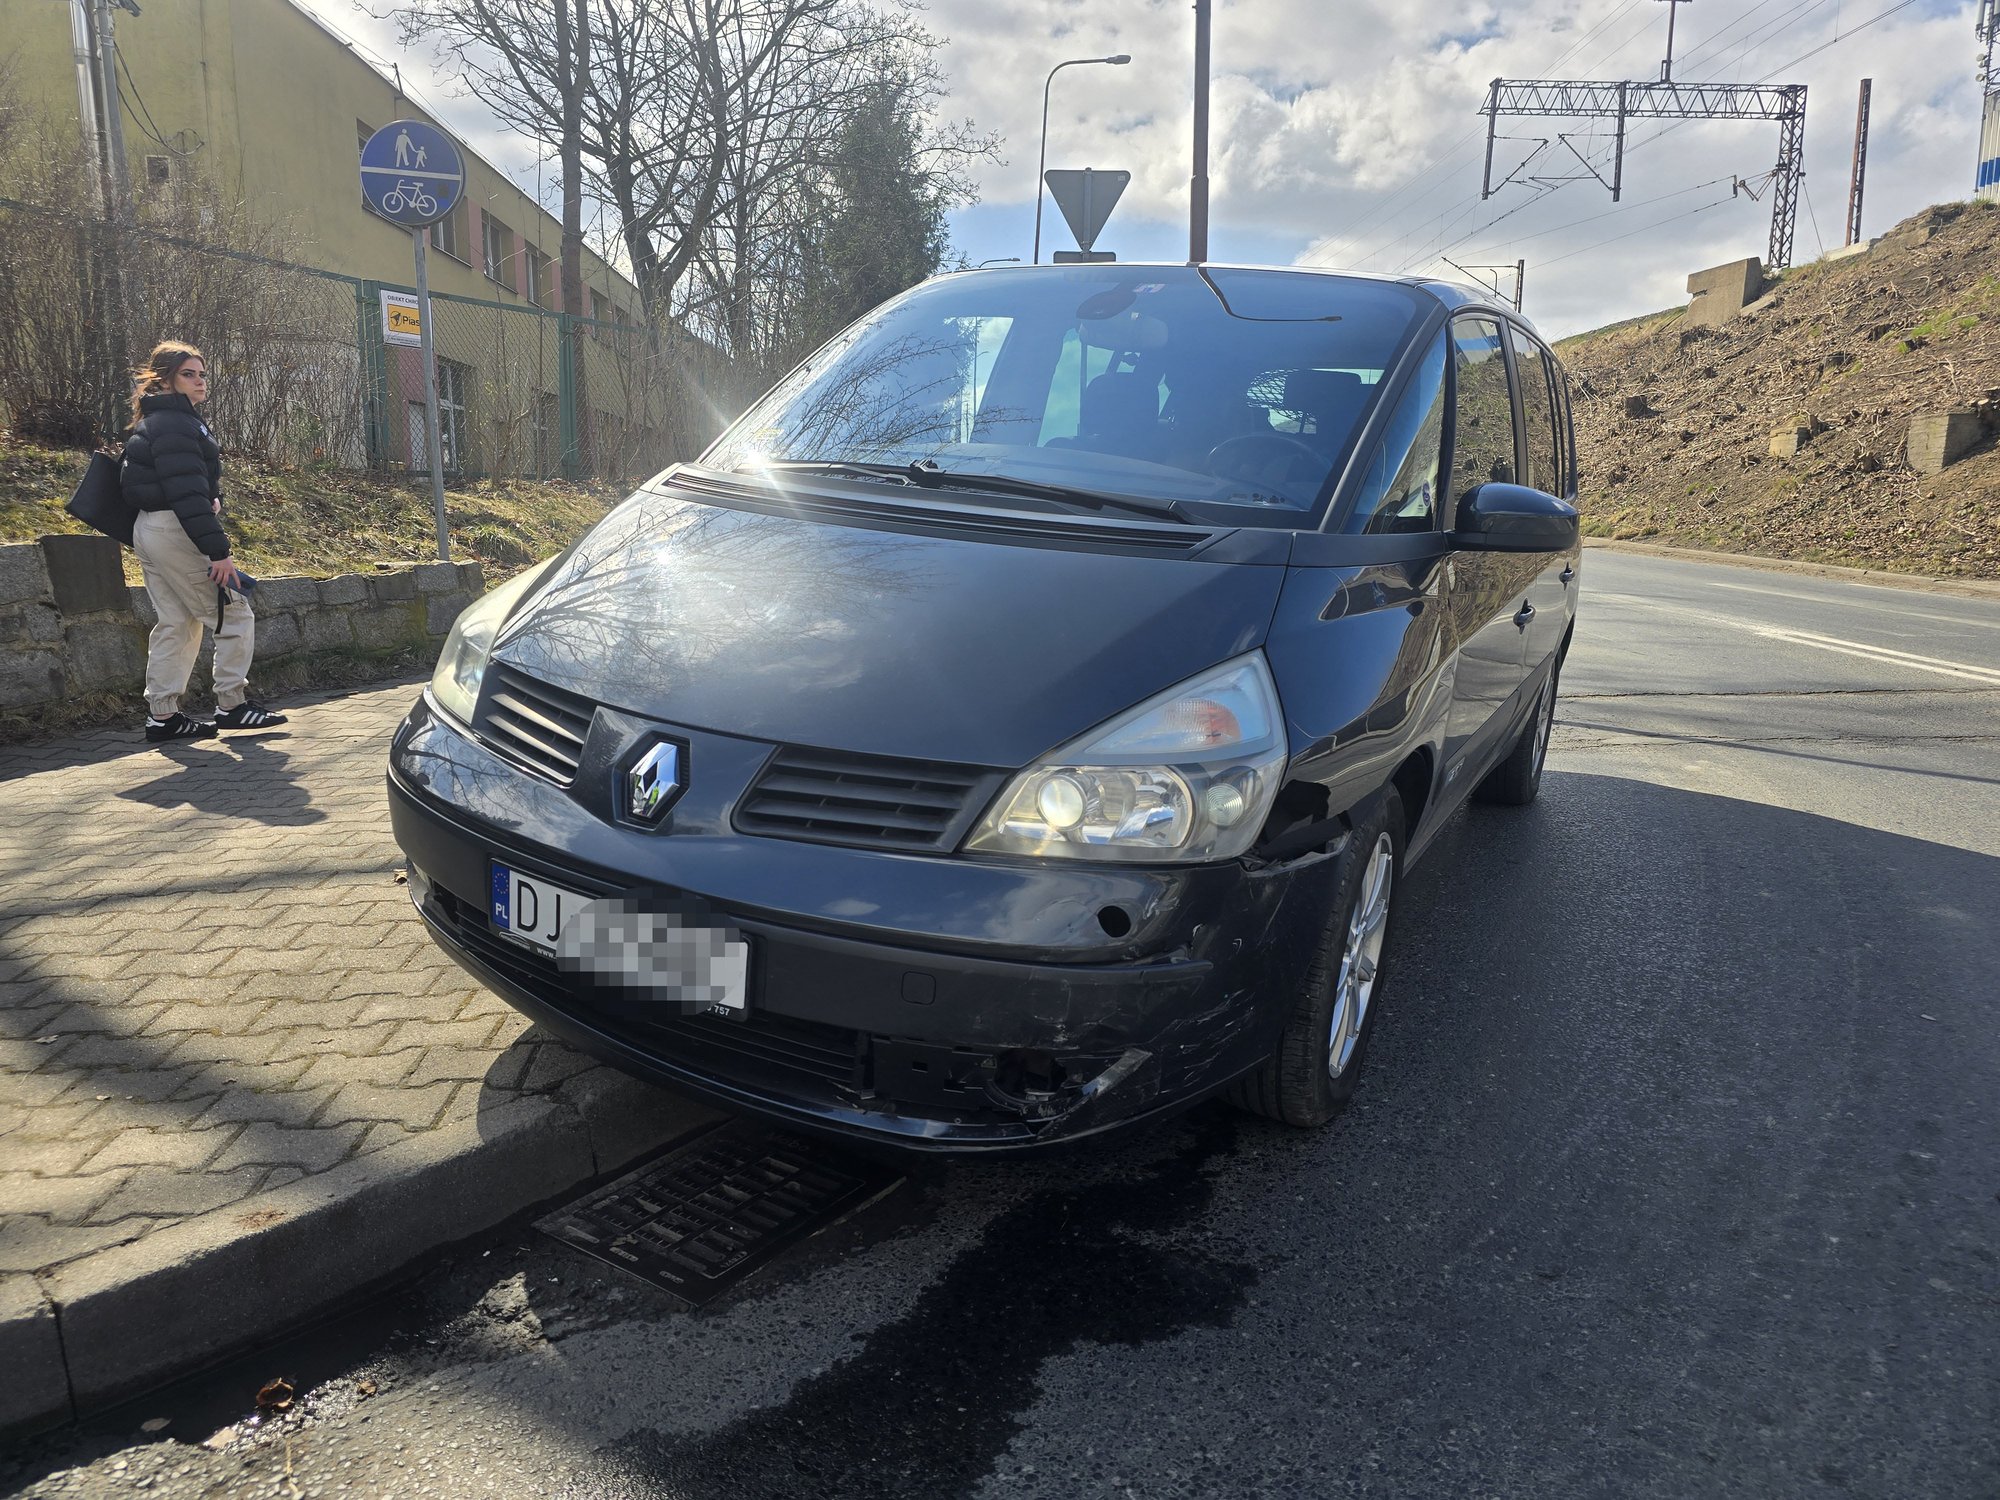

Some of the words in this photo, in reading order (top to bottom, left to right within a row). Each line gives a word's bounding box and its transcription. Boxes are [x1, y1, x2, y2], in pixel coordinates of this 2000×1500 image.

[402, 315, 420, 327] Pias
[495, 902, 508, 920] PL
[517, 879, 561, 942] DJ
[713, 1005, 730, 1016] 757
